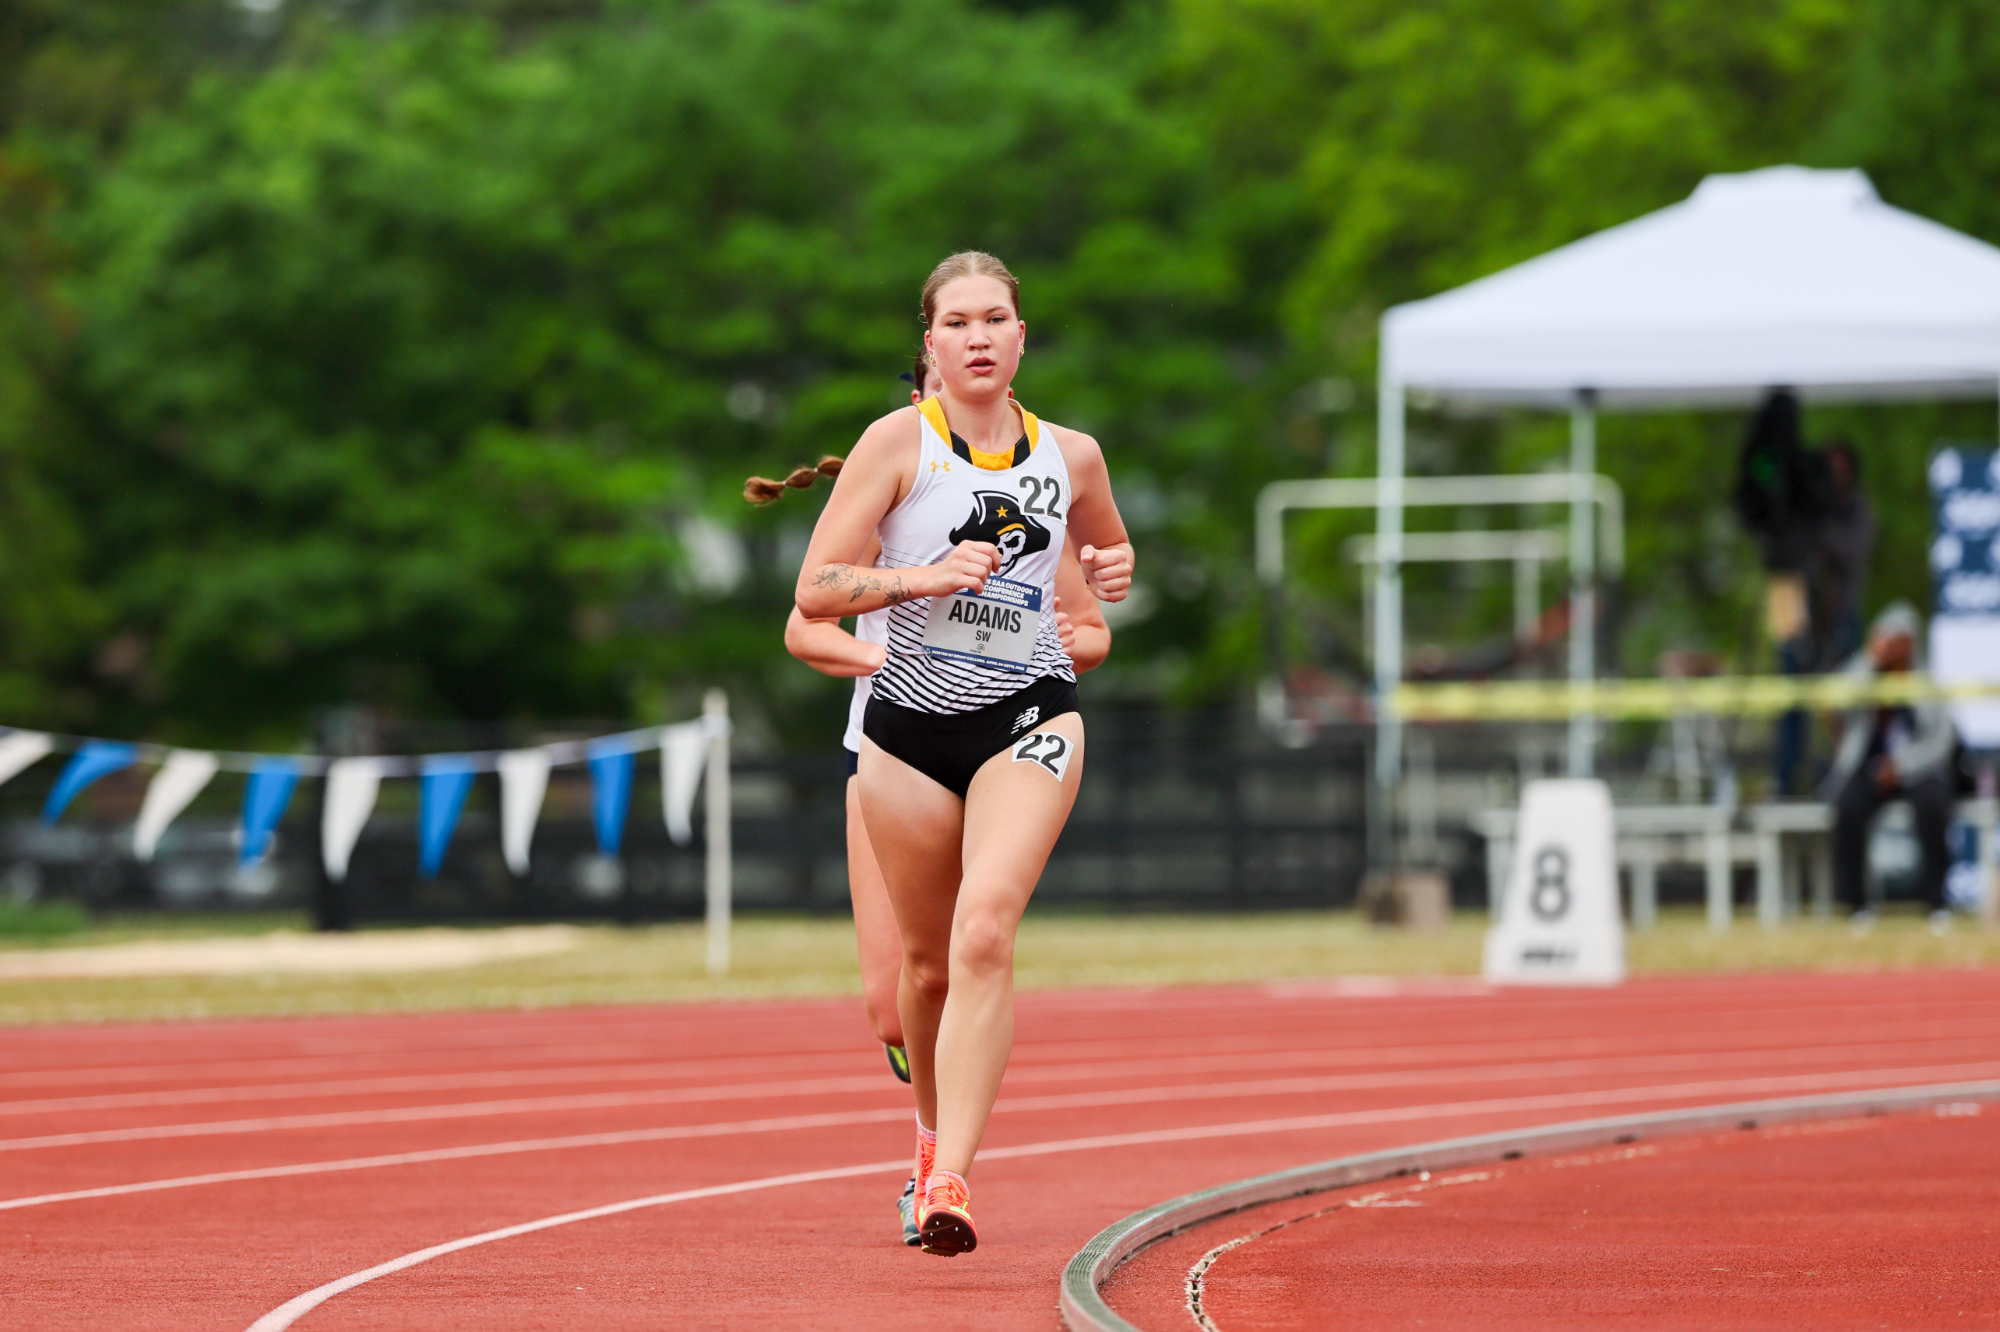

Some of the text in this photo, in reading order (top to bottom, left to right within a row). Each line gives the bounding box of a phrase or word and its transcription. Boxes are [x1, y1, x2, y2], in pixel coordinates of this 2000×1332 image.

[1019, 476, 1062, 520] 22
[984, 584, 1024, 599] CONFERENCE
[992, 579, 1005, 588] SAA
[1005, 582, 1034, 595] OUTDOOR
[947, 599, 1022, 634] ADAMS
[975, 629, 991, 642] SW
[1016, 734, 1066, 775] 22
[1529, 842, 1571, 924] 8
